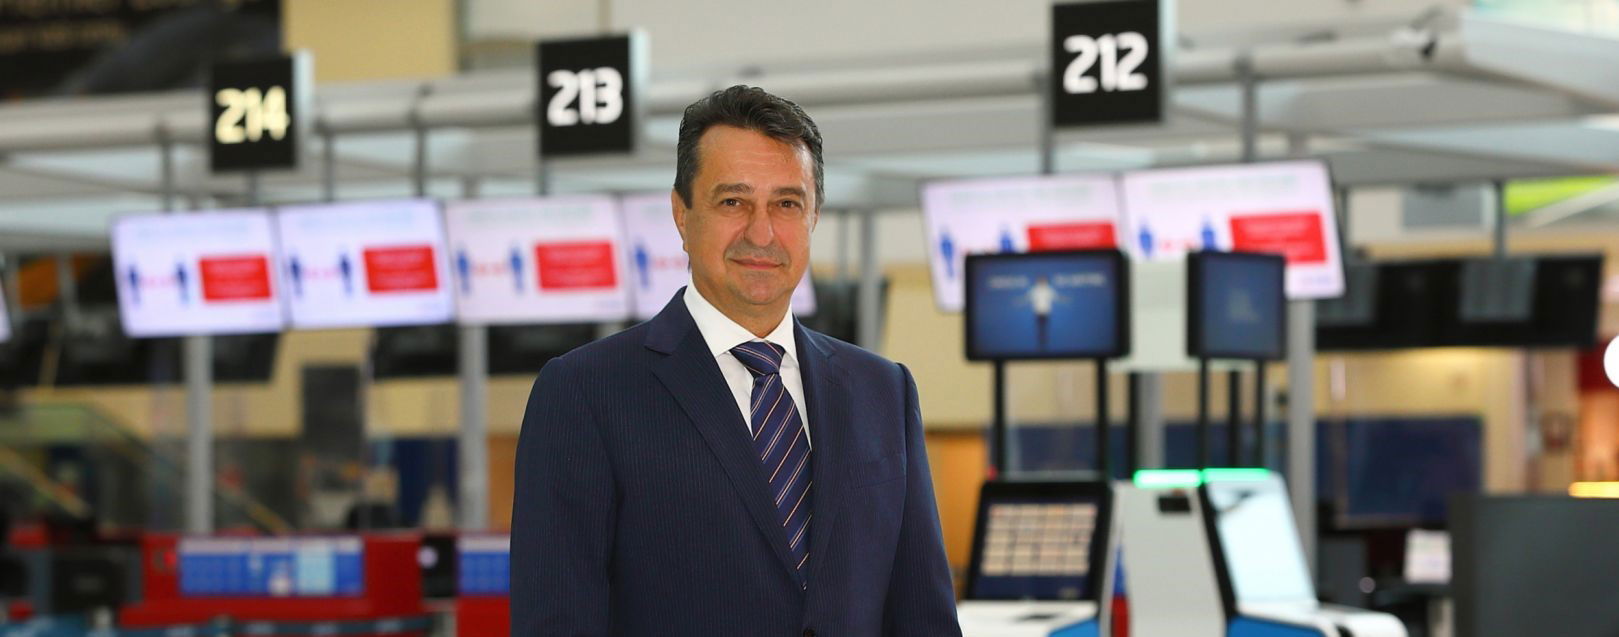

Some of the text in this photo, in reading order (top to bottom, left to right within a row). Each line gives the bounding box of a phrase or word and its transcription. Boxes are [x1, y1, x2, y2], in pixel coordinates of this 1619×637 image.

[1063, 31, 1149, 94] 212
[216, 86, 289, 144] 214
[547, 66, 623, 127] 213
